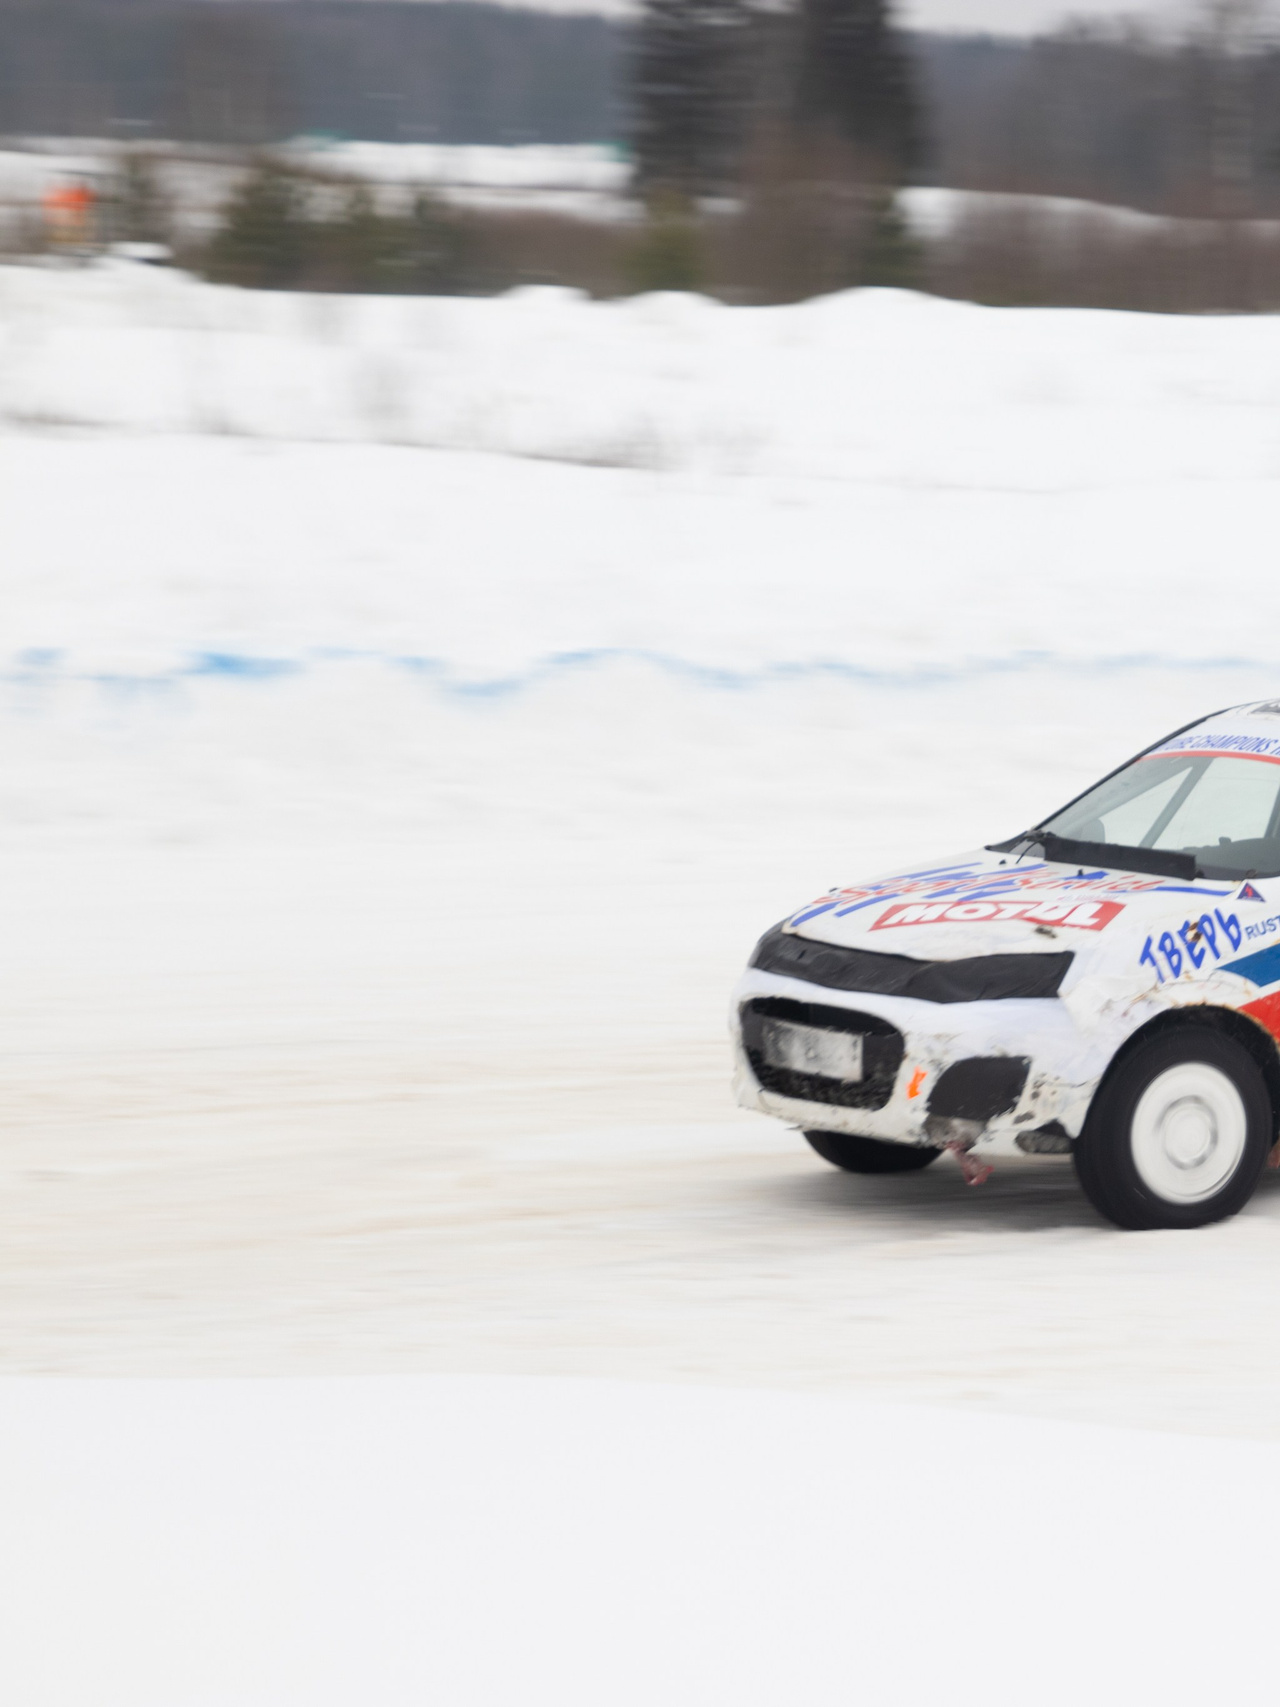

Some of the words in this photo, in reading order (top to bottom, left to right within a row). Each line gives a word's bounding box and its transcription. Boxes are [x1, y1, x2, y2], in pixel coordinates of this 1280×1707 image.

[1190, 734, 1278, 752] CHAMPIONS
[880, 900, 1105, 927] MOTUL
[1139, 908, 1243, 984] ТВЕРЬ
